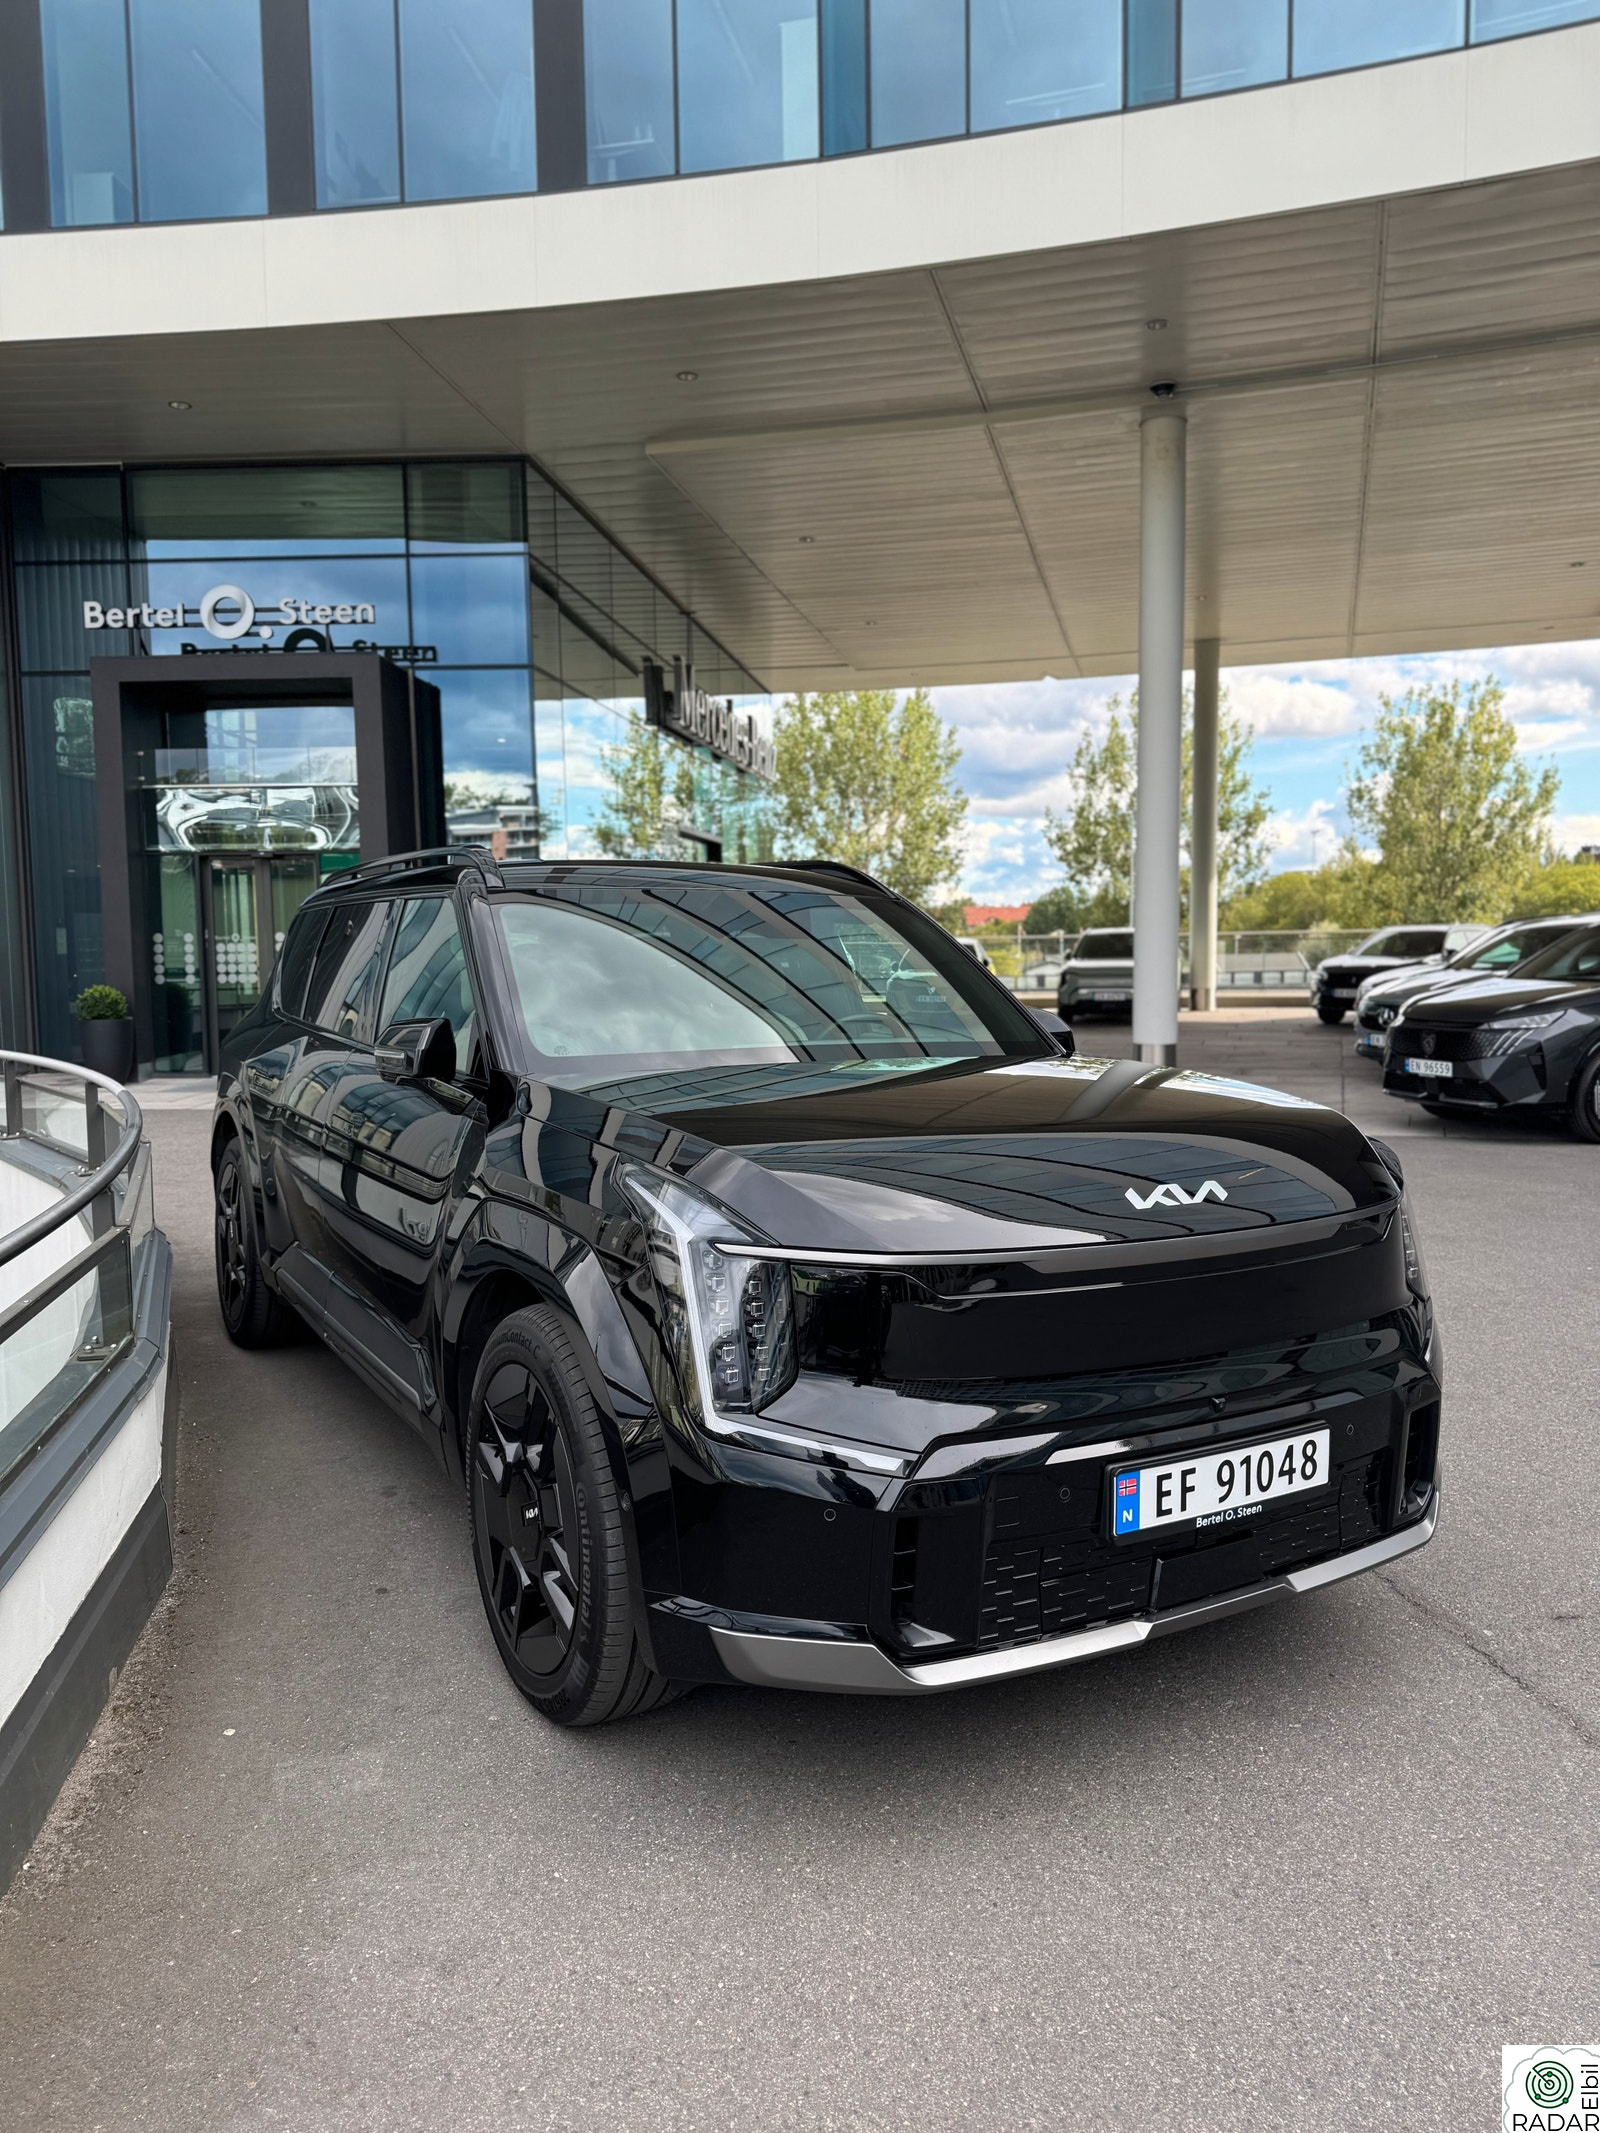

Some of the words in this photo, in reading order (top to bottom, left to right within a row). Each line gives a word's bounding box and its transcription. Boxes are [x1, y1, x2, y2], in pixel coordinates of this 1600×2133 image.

[83, 600, 185, 630] Bertel
[278, 598, 375, 625] Steen
[1410, 1060, 1421, 1072] EN
[1423, 1061, 1450, 1074] 96559
[1124, 1180, 1228, 1210] KIA
[1156, 1467, 1197, 1518] EF
[1216, 1439, 1318, 1504] 91048
[1122, 1508, 1133, 1524] N
[1196, 1511, 1224, 1528] Bertel
[1225, 1509, 1236, 1521] O.
[1237, 1504, 1263, 1518] Steen
[576, 1481, 595, 1631] Continental
